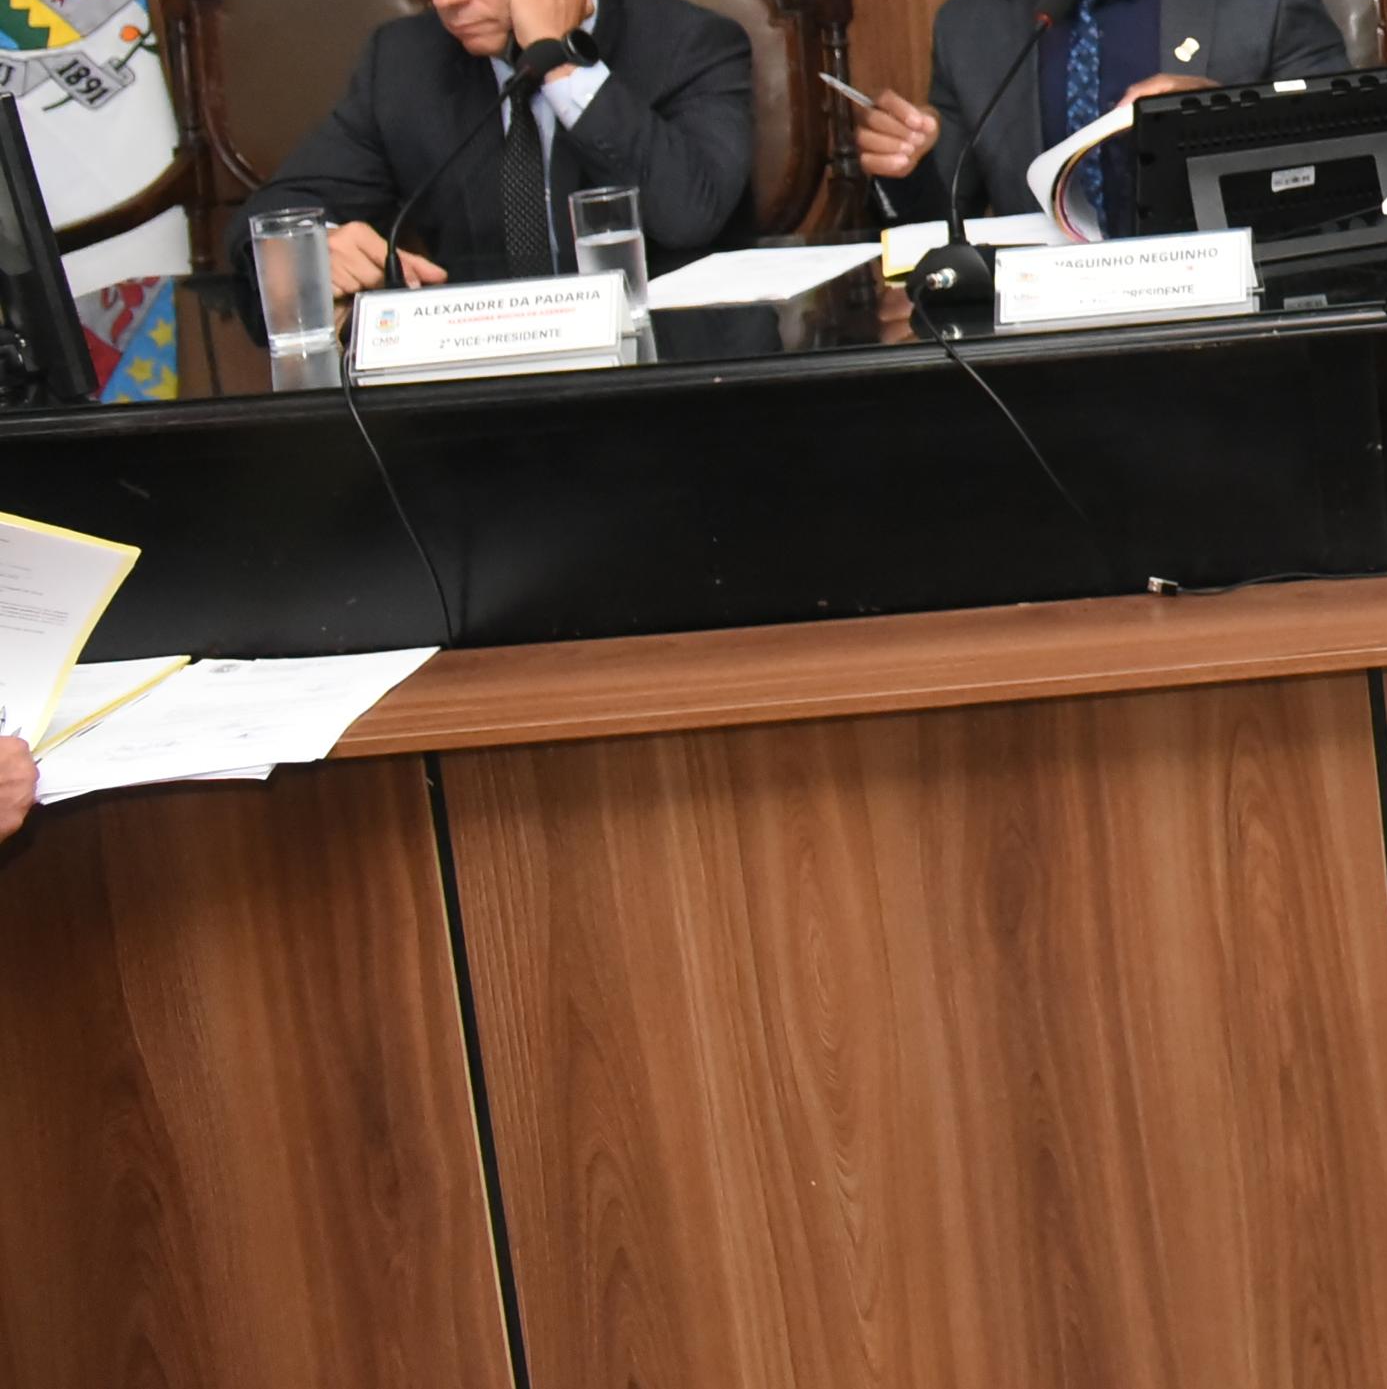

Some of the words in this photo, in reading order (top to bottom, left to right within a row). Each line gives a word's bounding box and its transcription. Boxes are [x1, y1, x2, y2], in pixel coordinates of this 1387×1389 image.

[58, 58, 109, 104] 1891
[1139, 247, 1218, 264] NEGUINHO
[413, 298, 505, 317] ALEXANDRE
[509, 296, 530, 308] DA
[535, 290, 601, 305] PADARIA
[454, 327, 562, 348] VICE-PRESIDENTE
